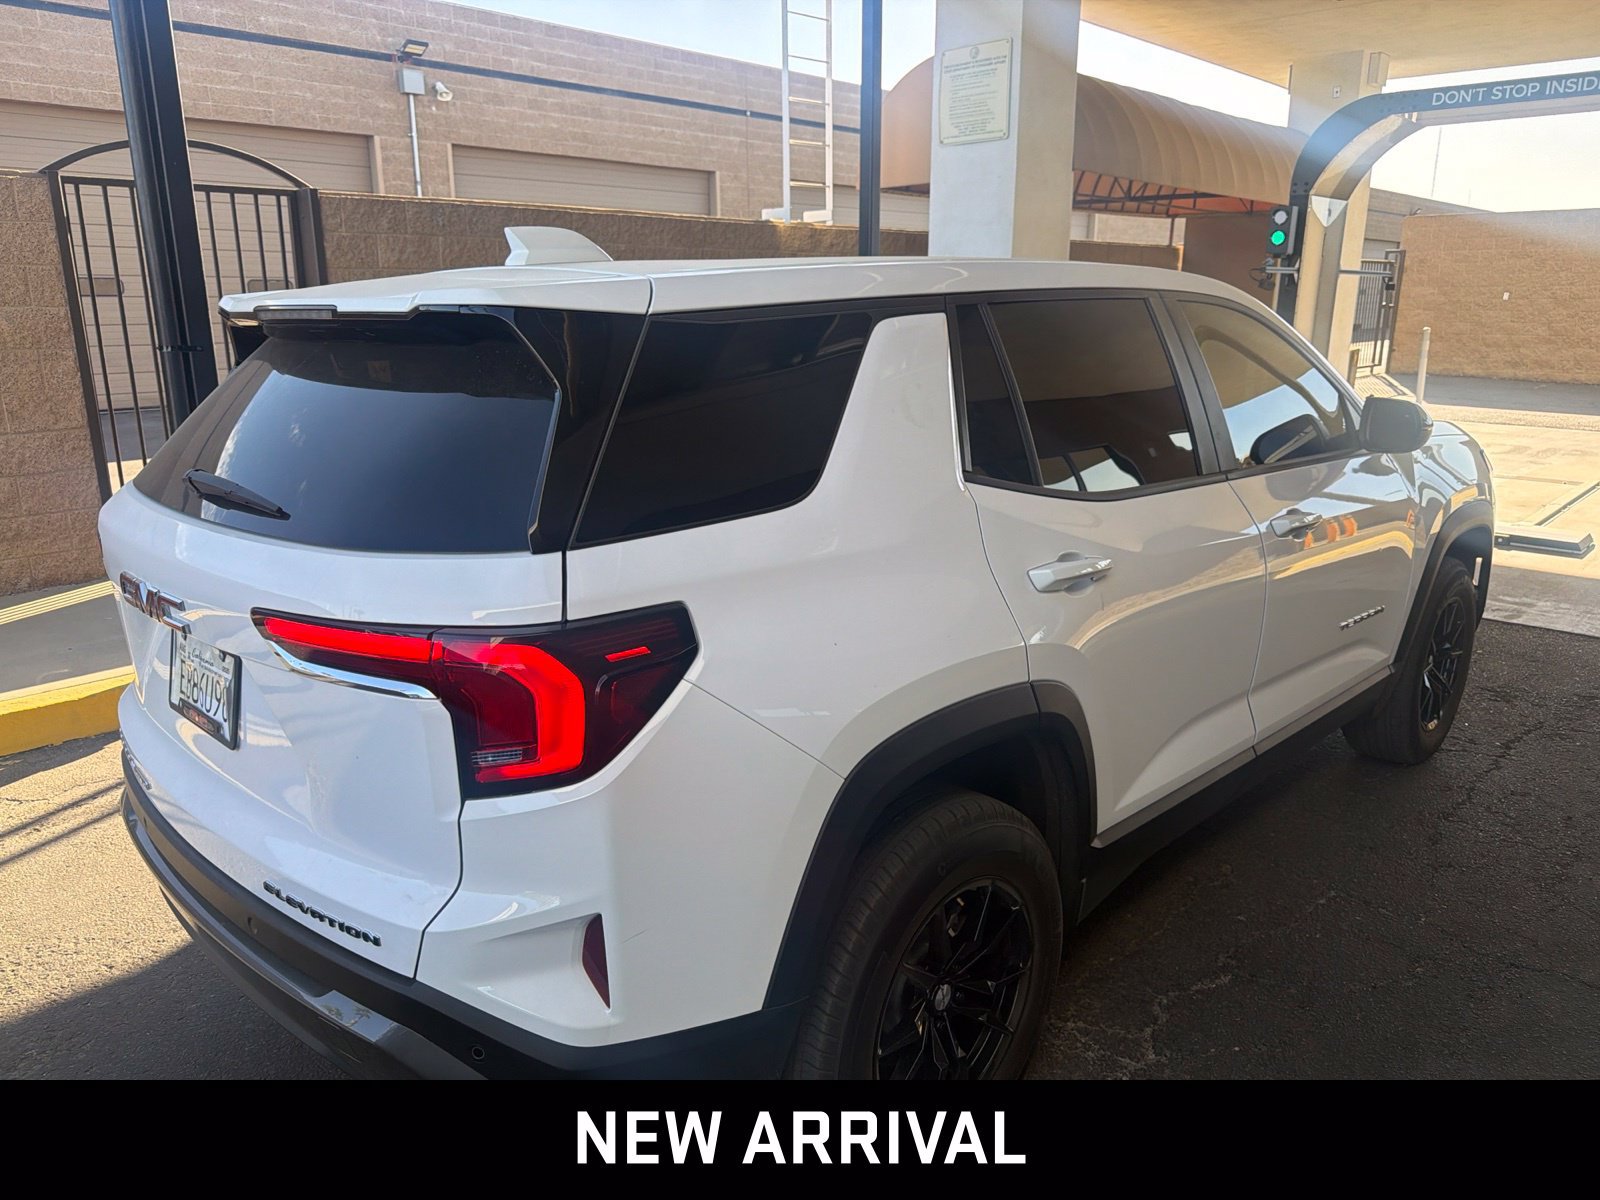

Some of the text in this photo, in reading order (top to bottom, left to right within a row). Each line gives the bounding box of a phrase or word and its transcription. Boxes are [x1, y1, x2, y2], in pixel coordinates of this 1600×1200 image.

[1431, 76, 1600, 106] DON'T STOP INSID
[263, 880, 382, 947] ELEVATION
